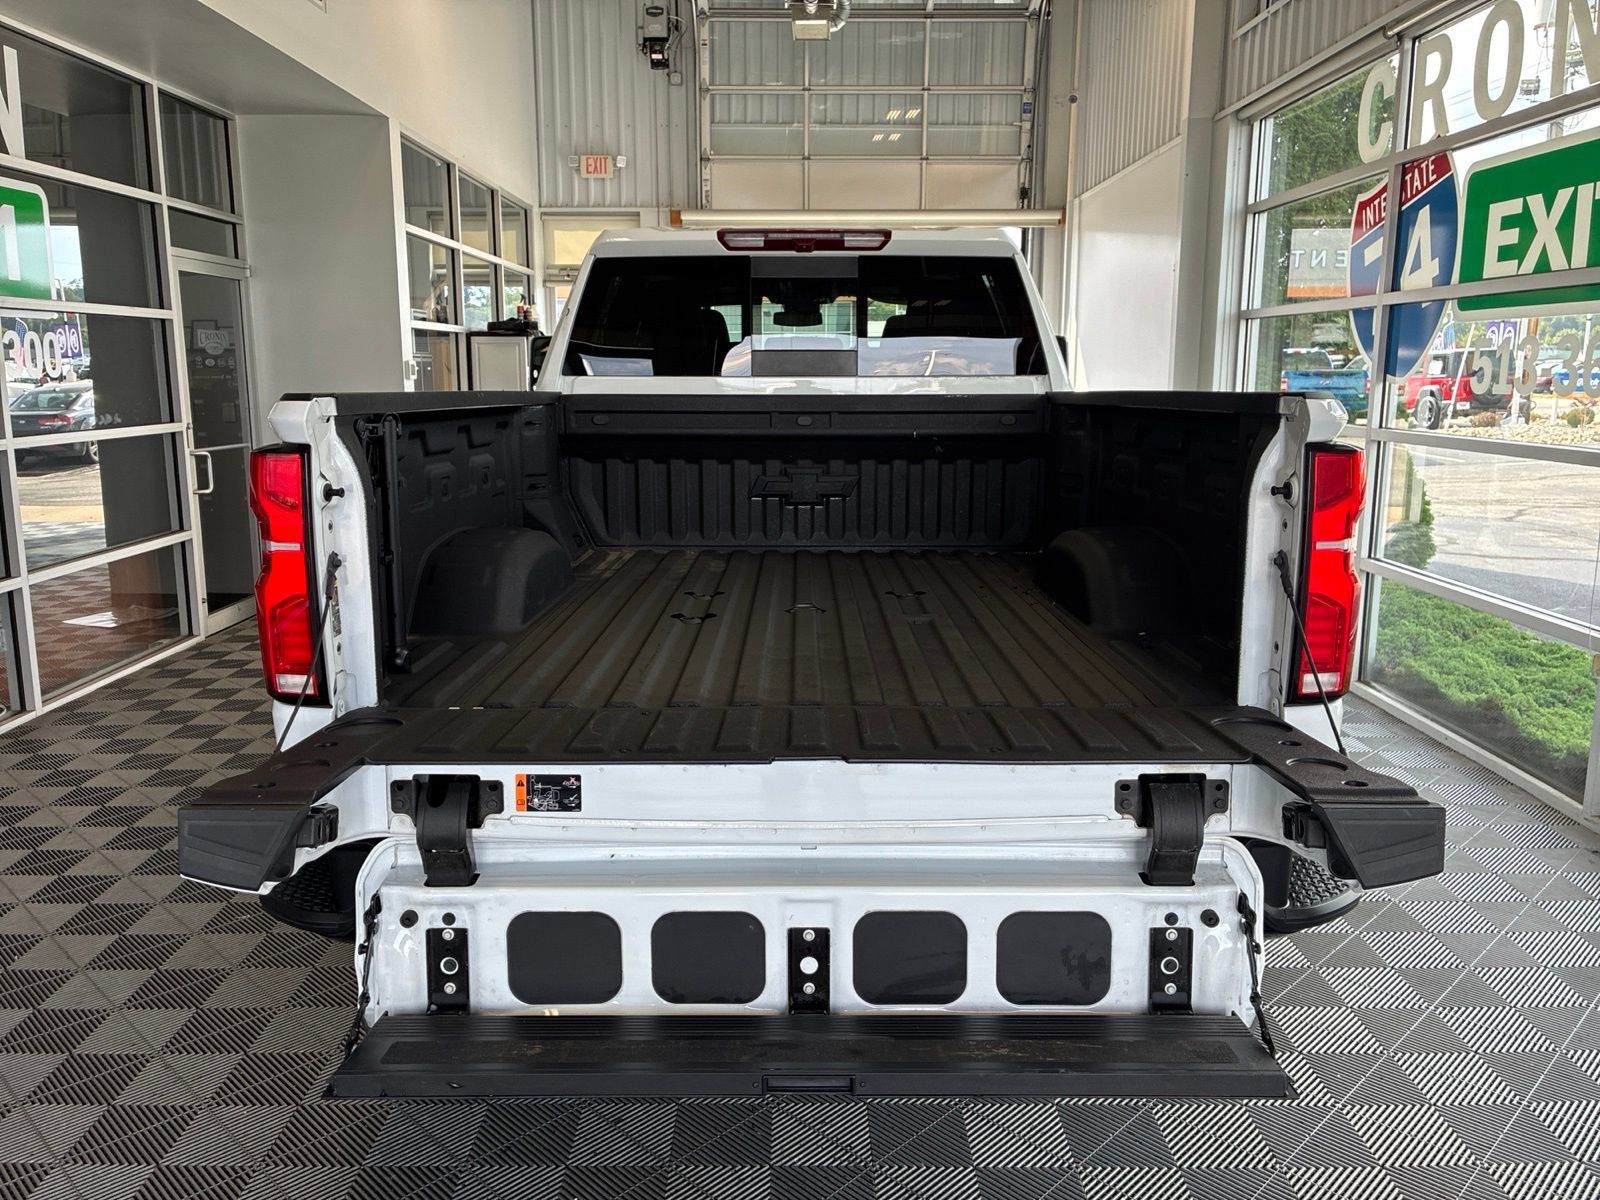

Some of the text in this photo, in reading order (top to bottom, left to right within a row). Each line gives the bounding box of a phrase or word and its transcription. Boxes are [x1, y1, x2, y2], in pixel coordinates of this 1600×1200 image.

[585, 156, 609, 175] EXIT
[1362, 155, 1437, 232] INTETATE
[1482, 180, 1600, 280] EXI
[2, 330, 62, 379] 300
